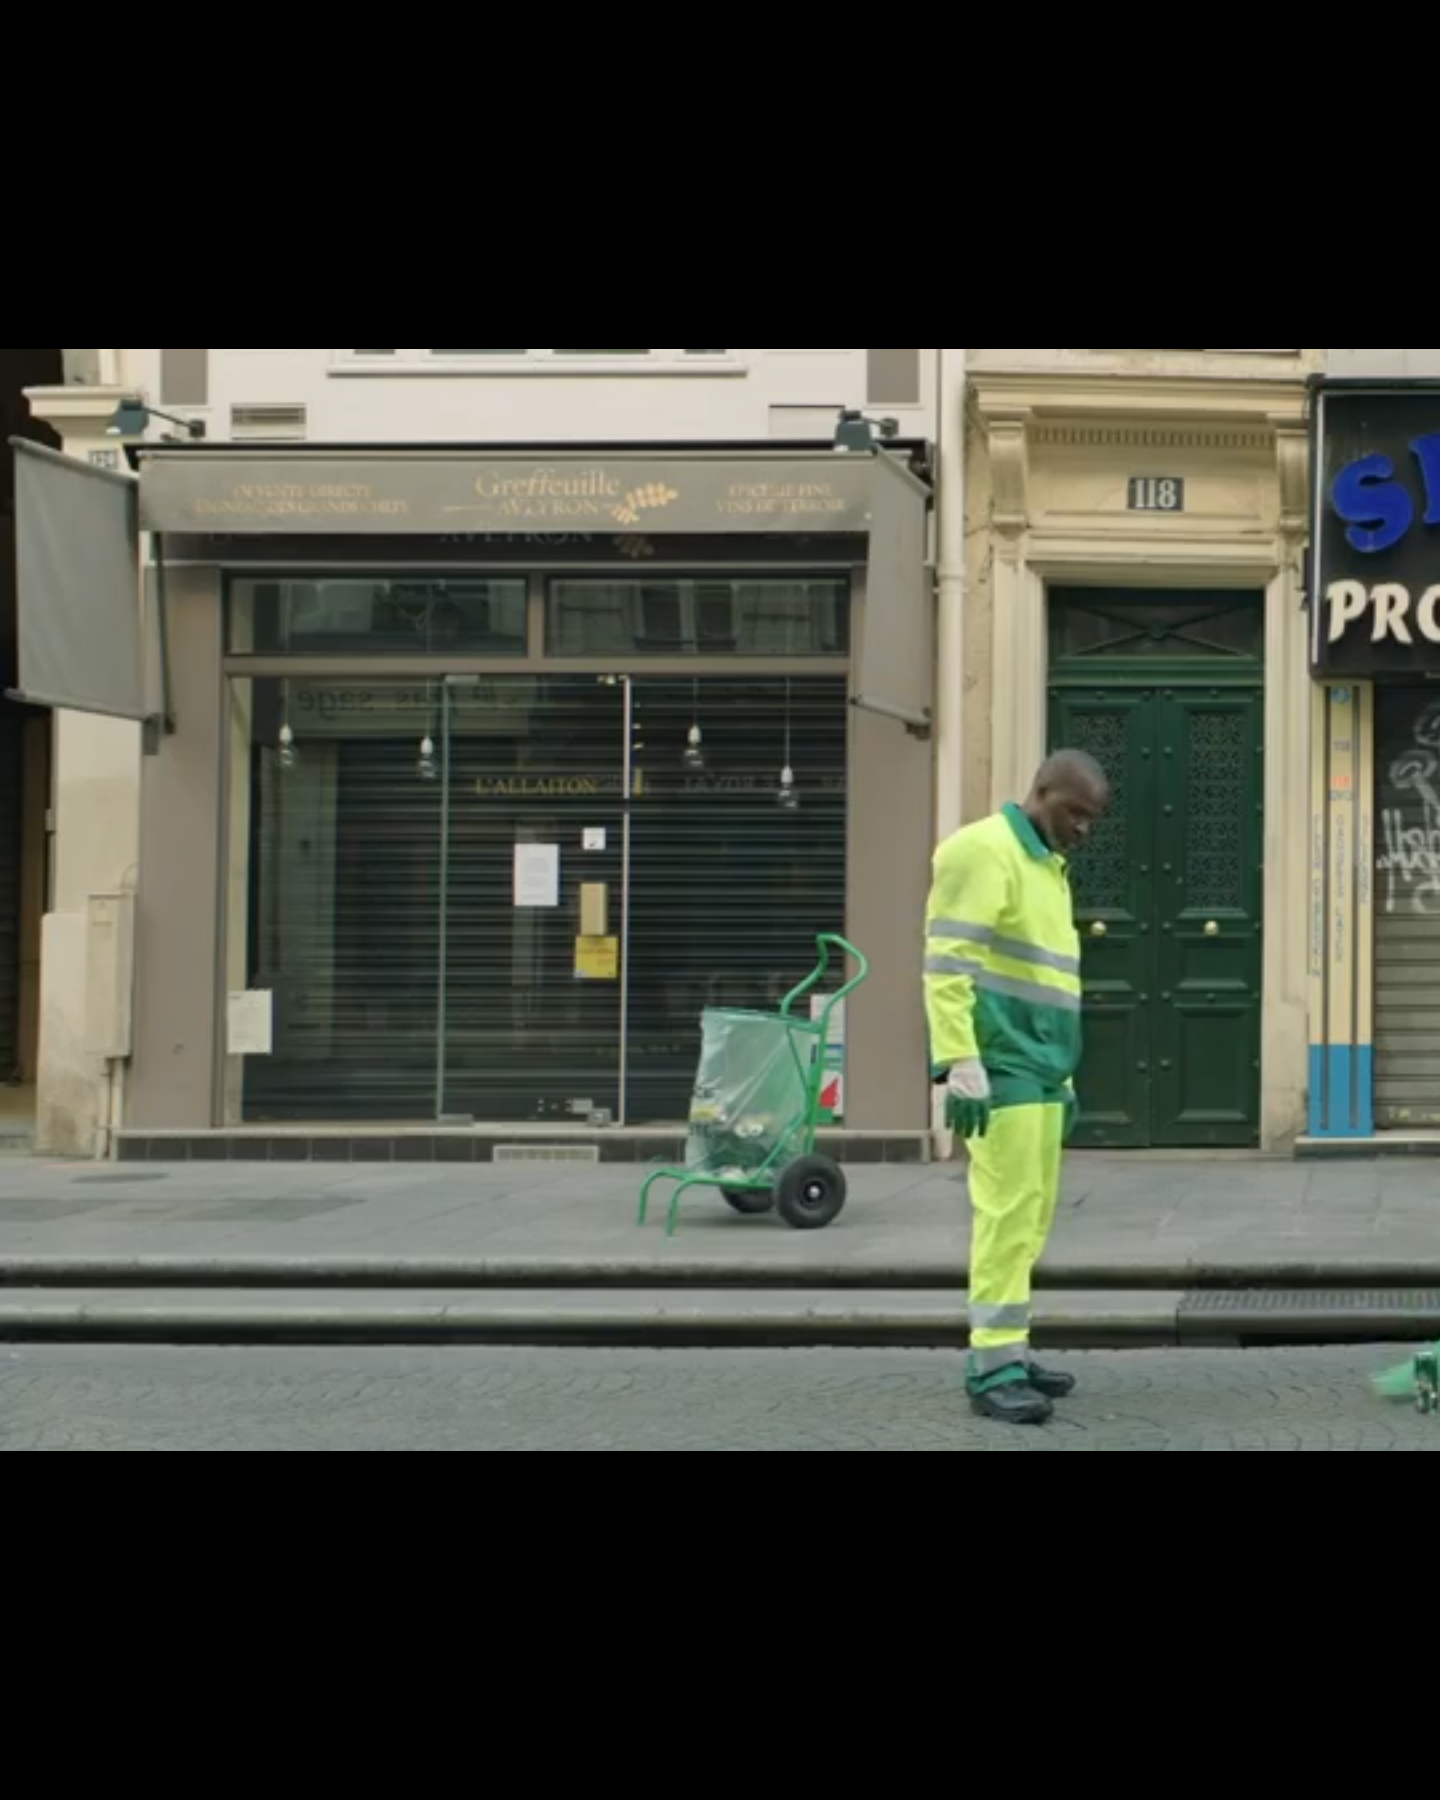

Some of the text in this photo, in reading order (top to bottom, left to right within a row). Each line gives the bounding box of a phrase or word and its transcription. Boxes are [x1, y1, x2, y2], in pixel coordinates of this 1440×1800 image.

[474, 467, 620, 498] Greffeuille
[1134, 479, 1177, 508] 118
[499, 500, 599, 516] AVEYRON
